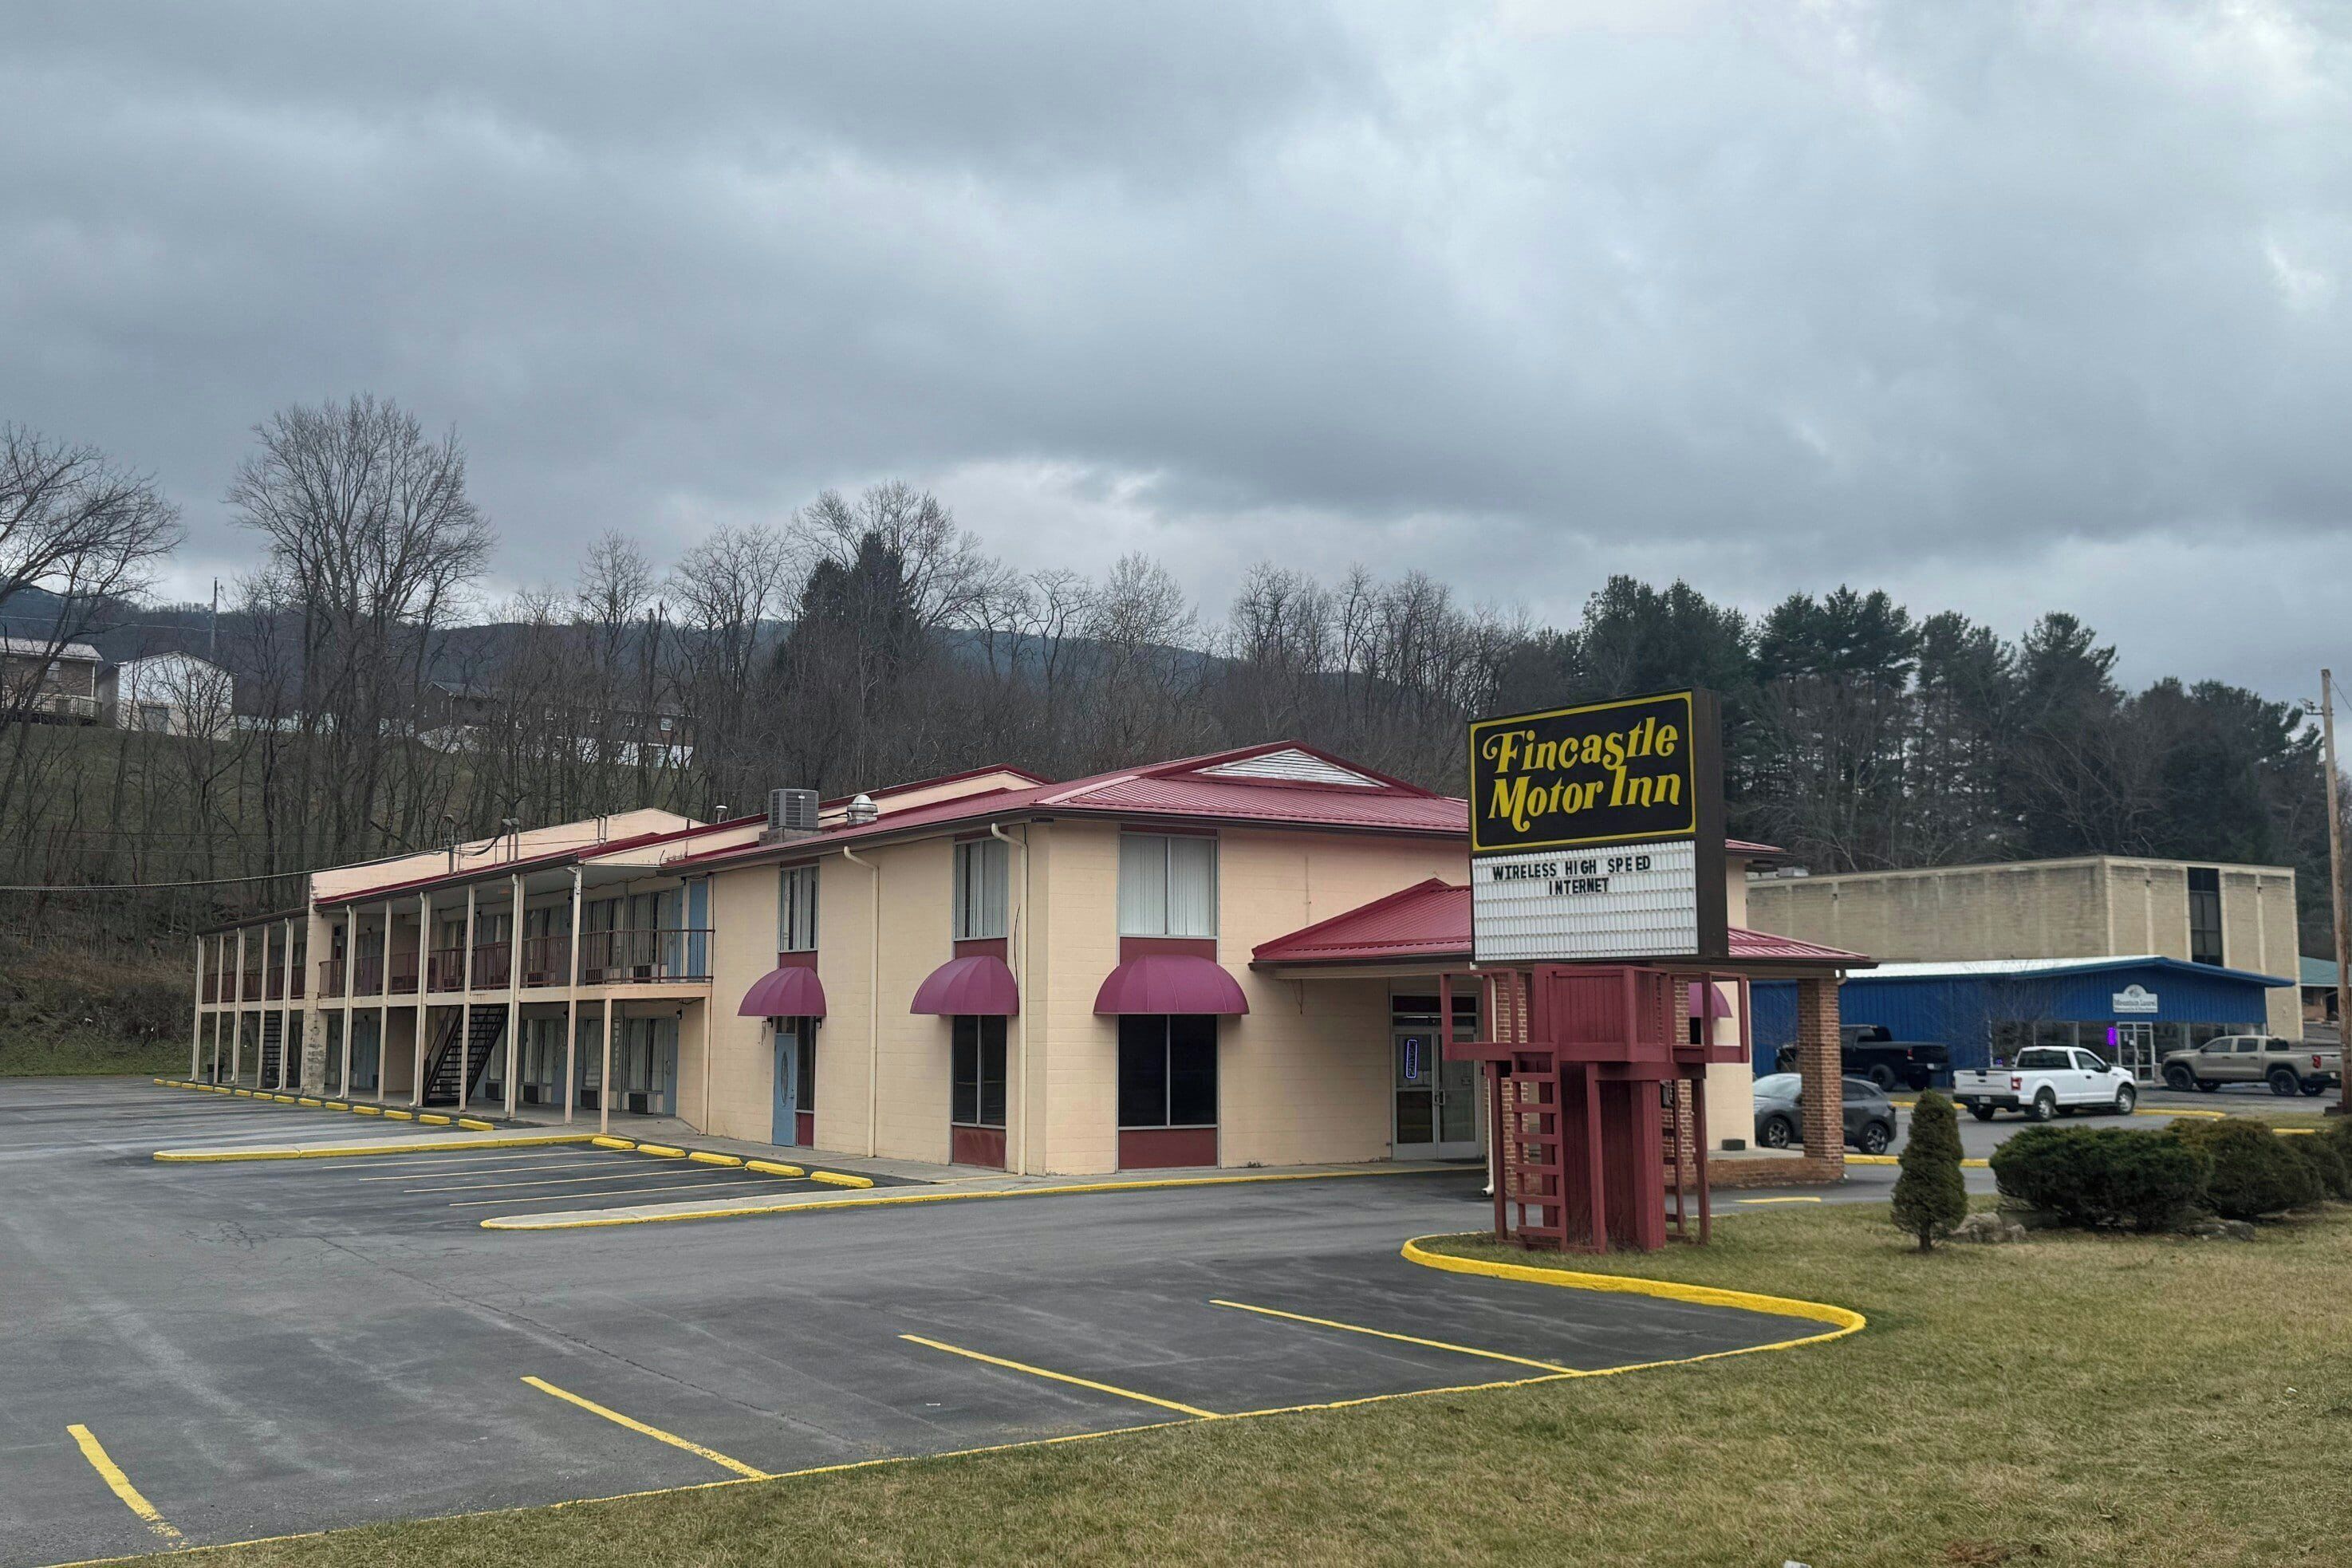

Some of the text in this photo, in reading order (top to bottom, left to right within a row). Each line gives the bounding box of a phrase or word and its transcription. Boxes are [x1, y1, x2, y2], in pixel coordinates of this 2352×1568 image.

[1483, 716, 1678, 773] Fincastle
[1488, 766, 1680, 832] Motor Inn
[1493, 856, 1650, 880] WIRELESS HIGH SPEED
[1550, 878, 1609, 895] INTERNET
